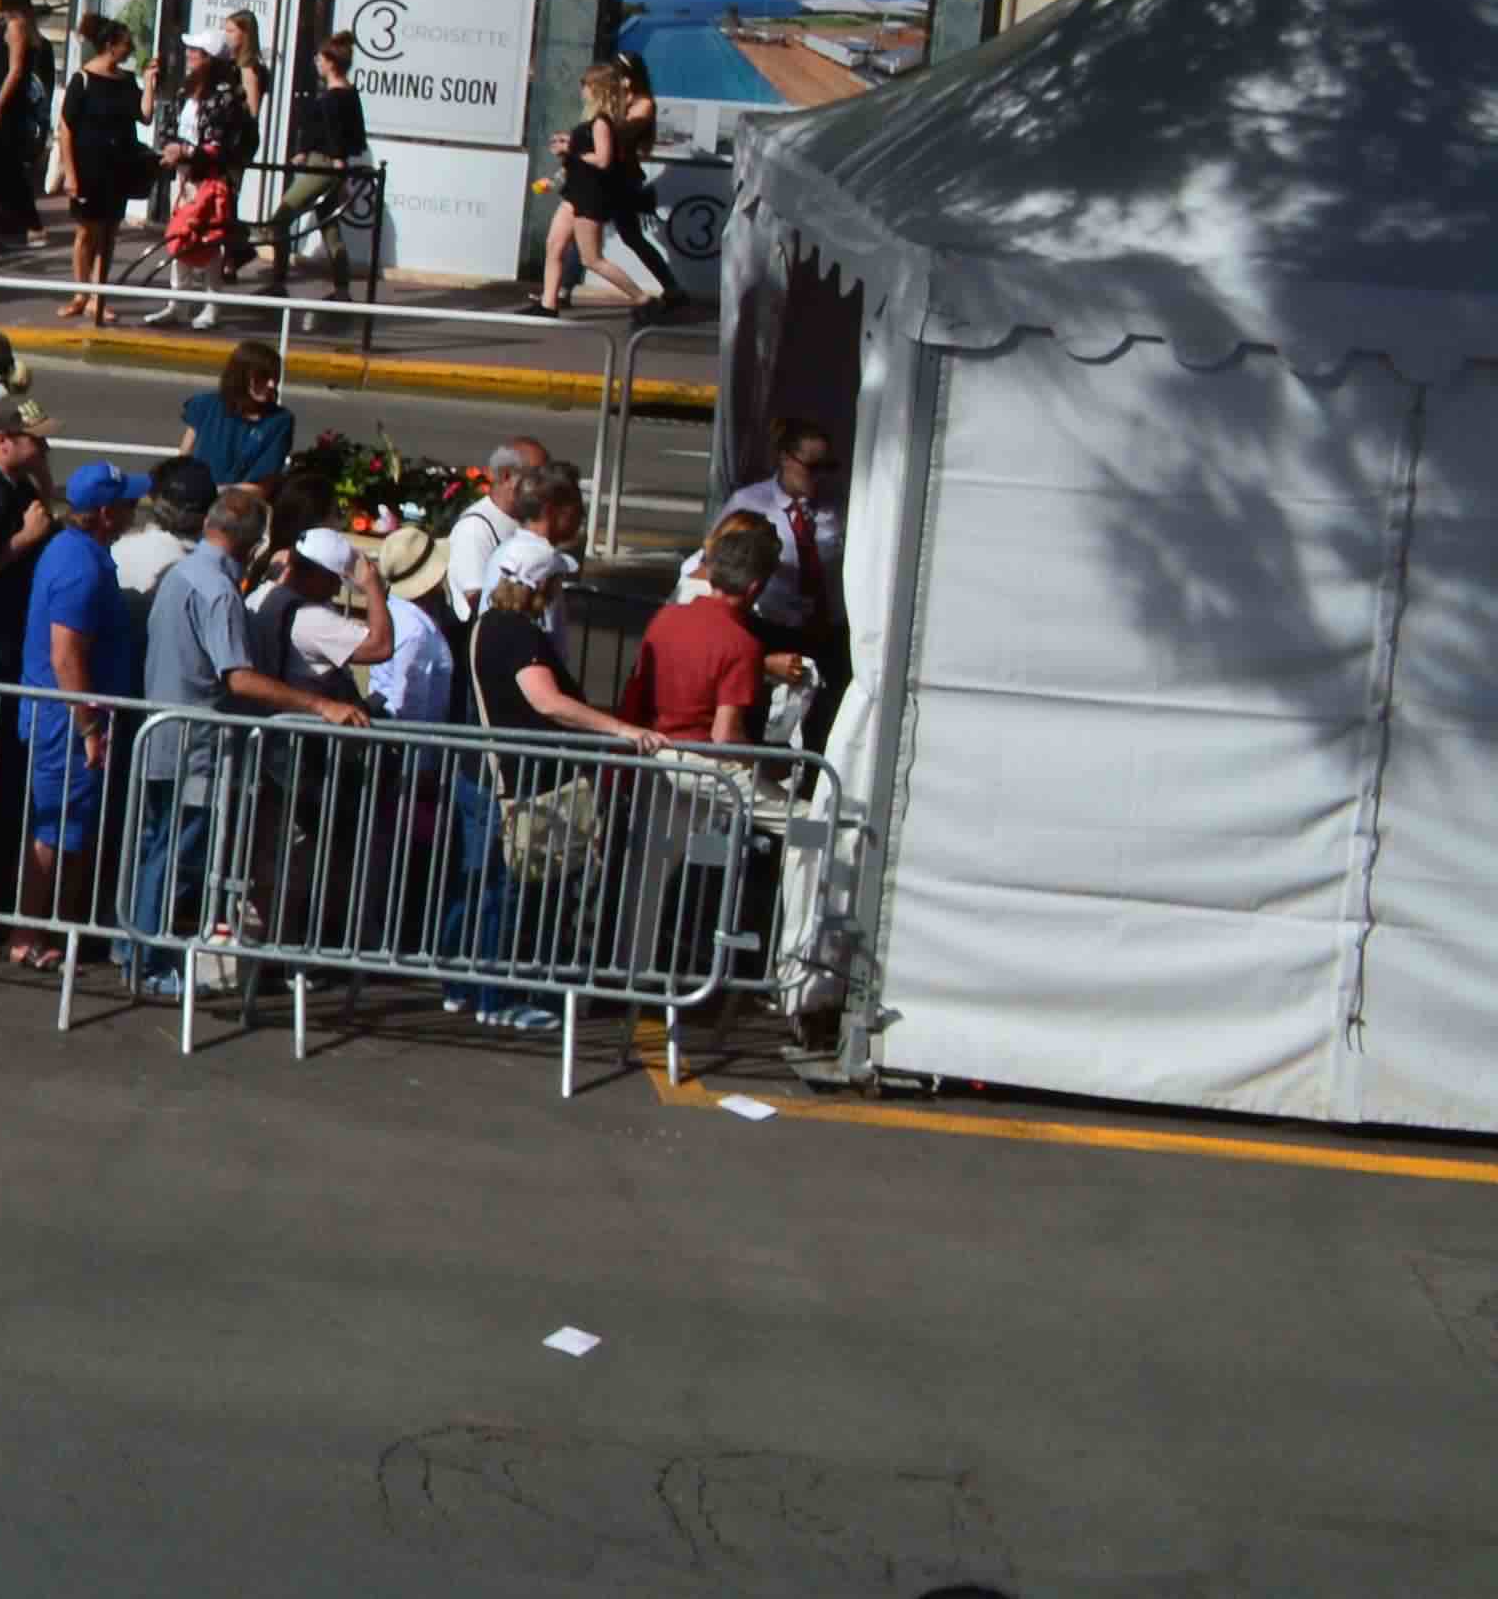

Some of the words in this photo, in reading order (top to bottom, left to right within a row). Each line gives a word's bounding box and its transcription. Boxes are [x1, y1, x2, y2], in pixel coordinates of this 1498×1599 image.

[402, 24, 511, 48] CROISETTE
[355, 67, 435, 101] COMING
[440, 76, 498, 106] SOON
